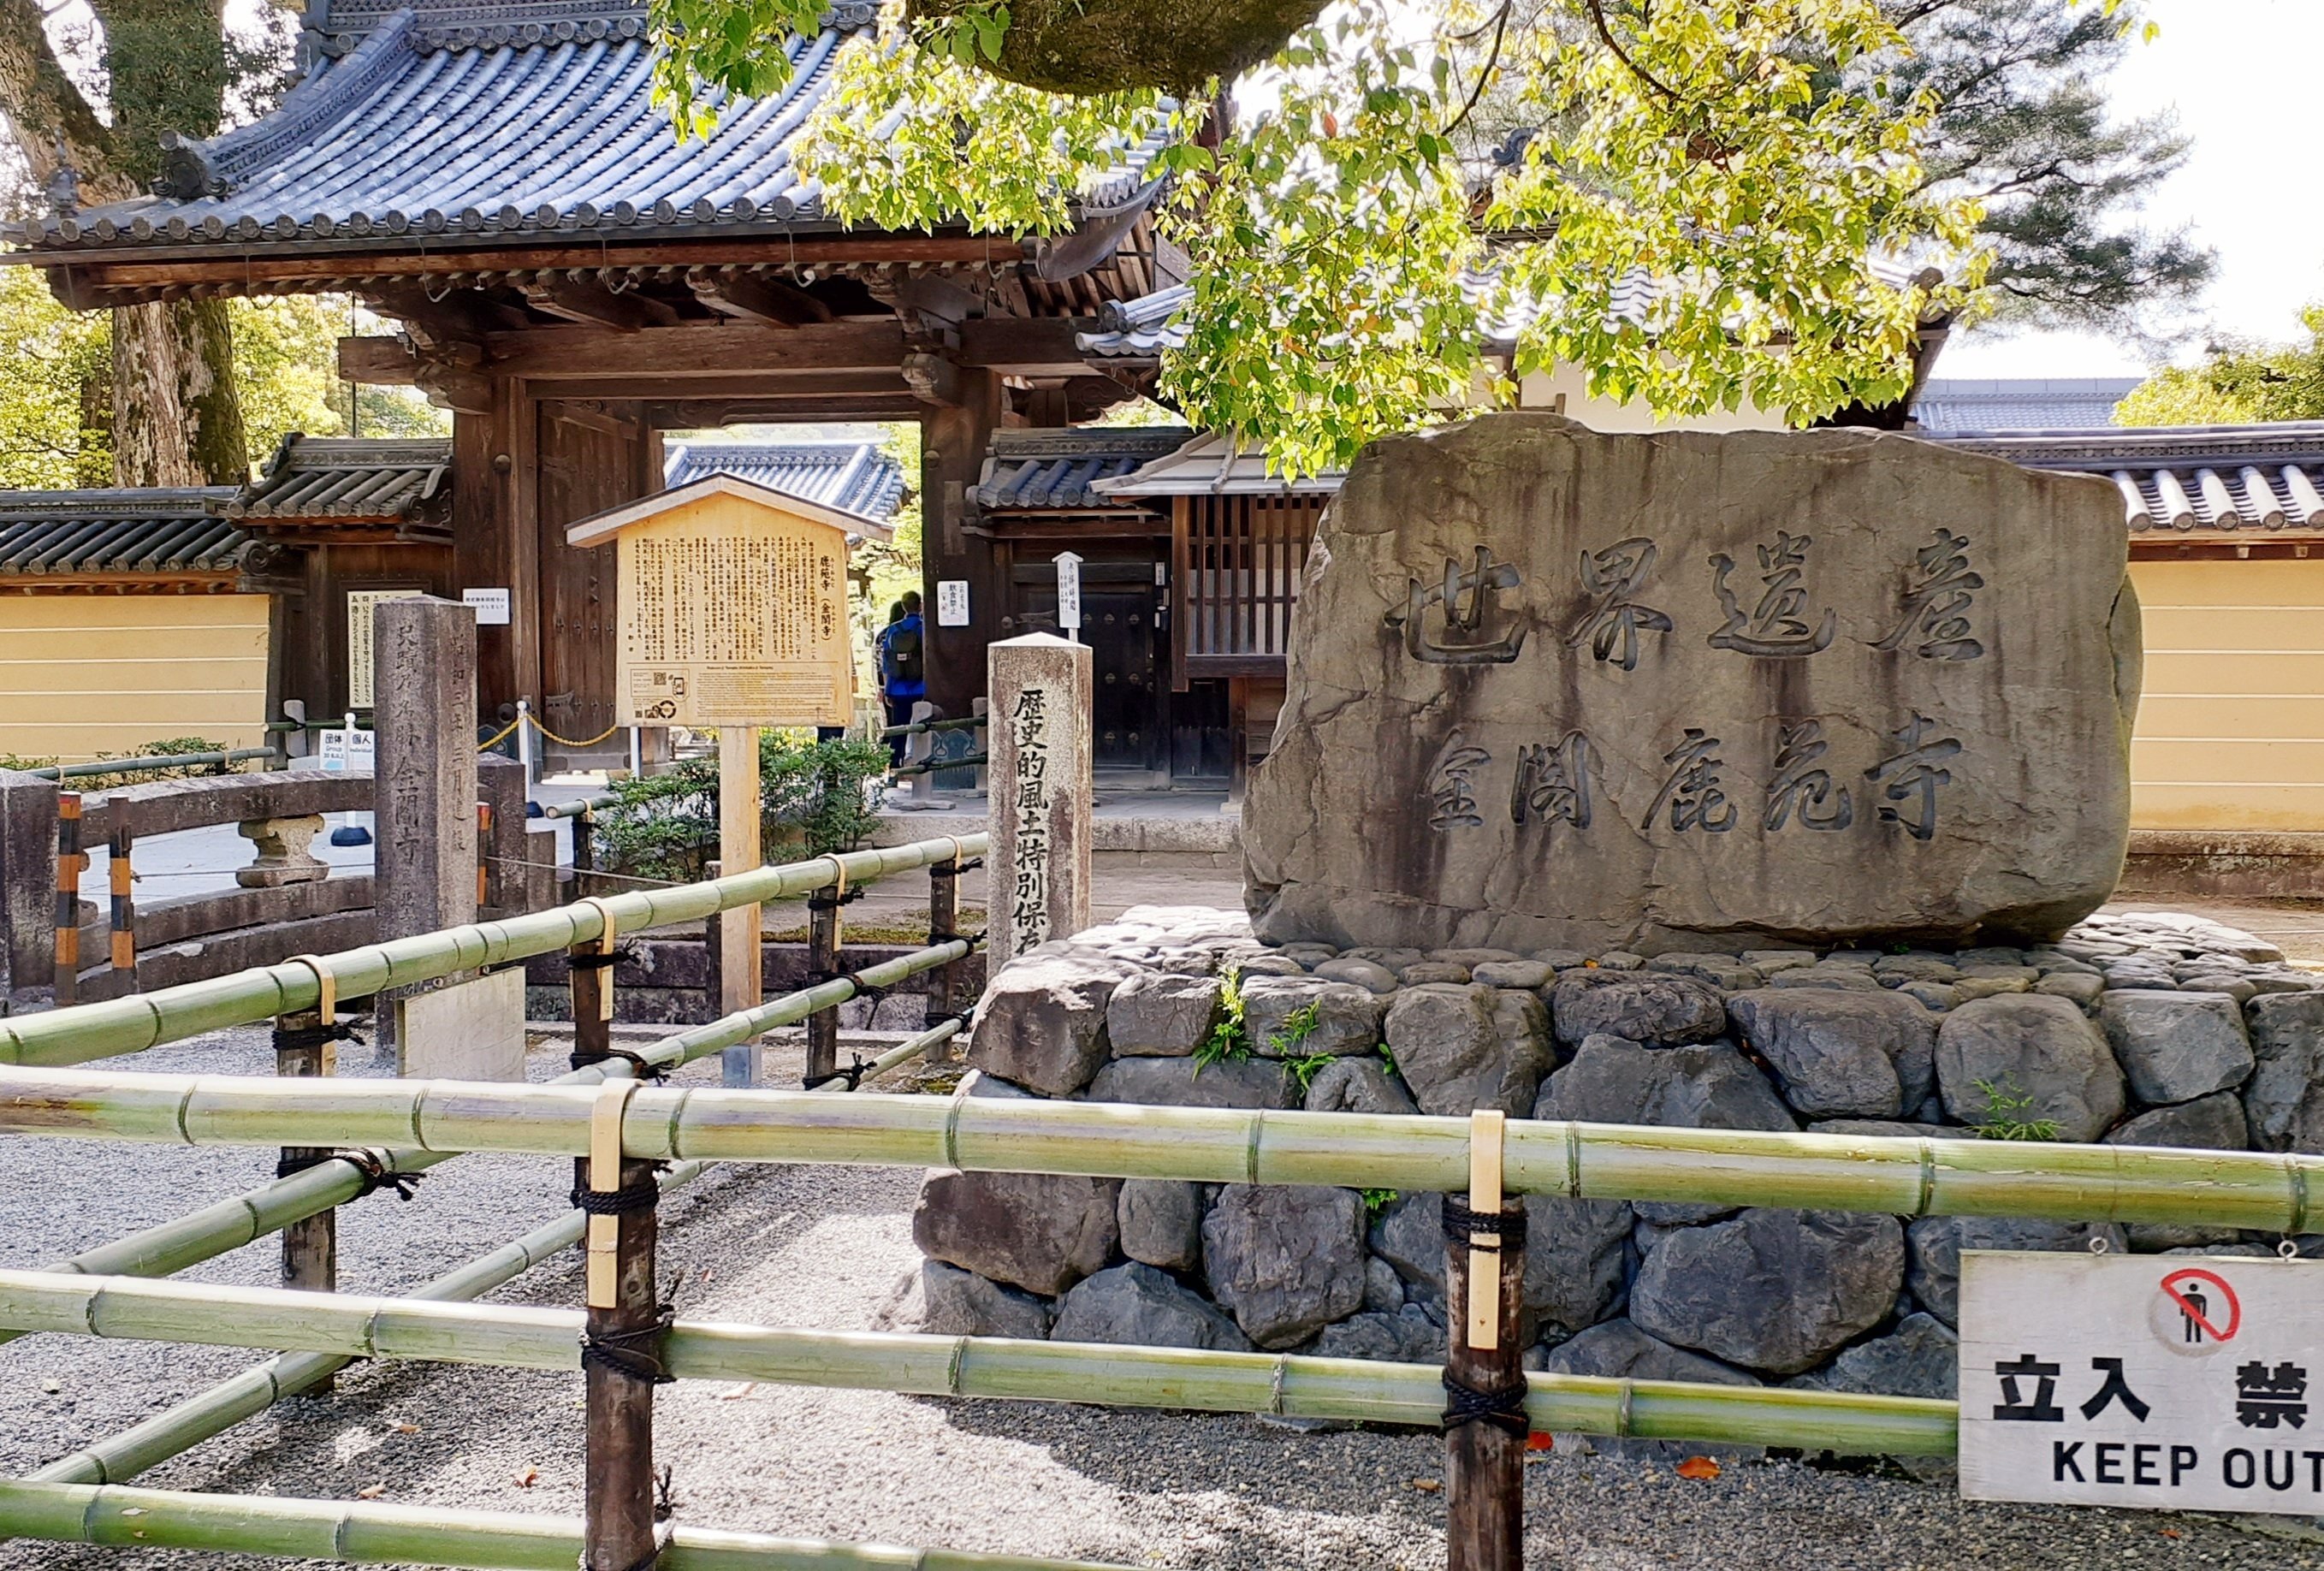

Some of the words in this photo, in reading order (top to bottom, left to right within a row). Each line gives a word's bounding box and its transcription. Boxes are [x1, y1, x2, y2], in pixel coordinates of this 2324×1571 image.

[820, 554, 832, 641] 鹿苑寺（金閣寺）
[949, 584, 957, 614] 飲食禁止
[1384, 527, 1985, 673] 世界遺産
[325, 733, 342, 744] 団体
[353, 734, 371, 744] 個人
[1012, 690, 1048, 955] 歴史的風土特別保存
[2054, 1441, 2198, 1486] KEEP
[2223, 1448, 2324, 1492] OUT
